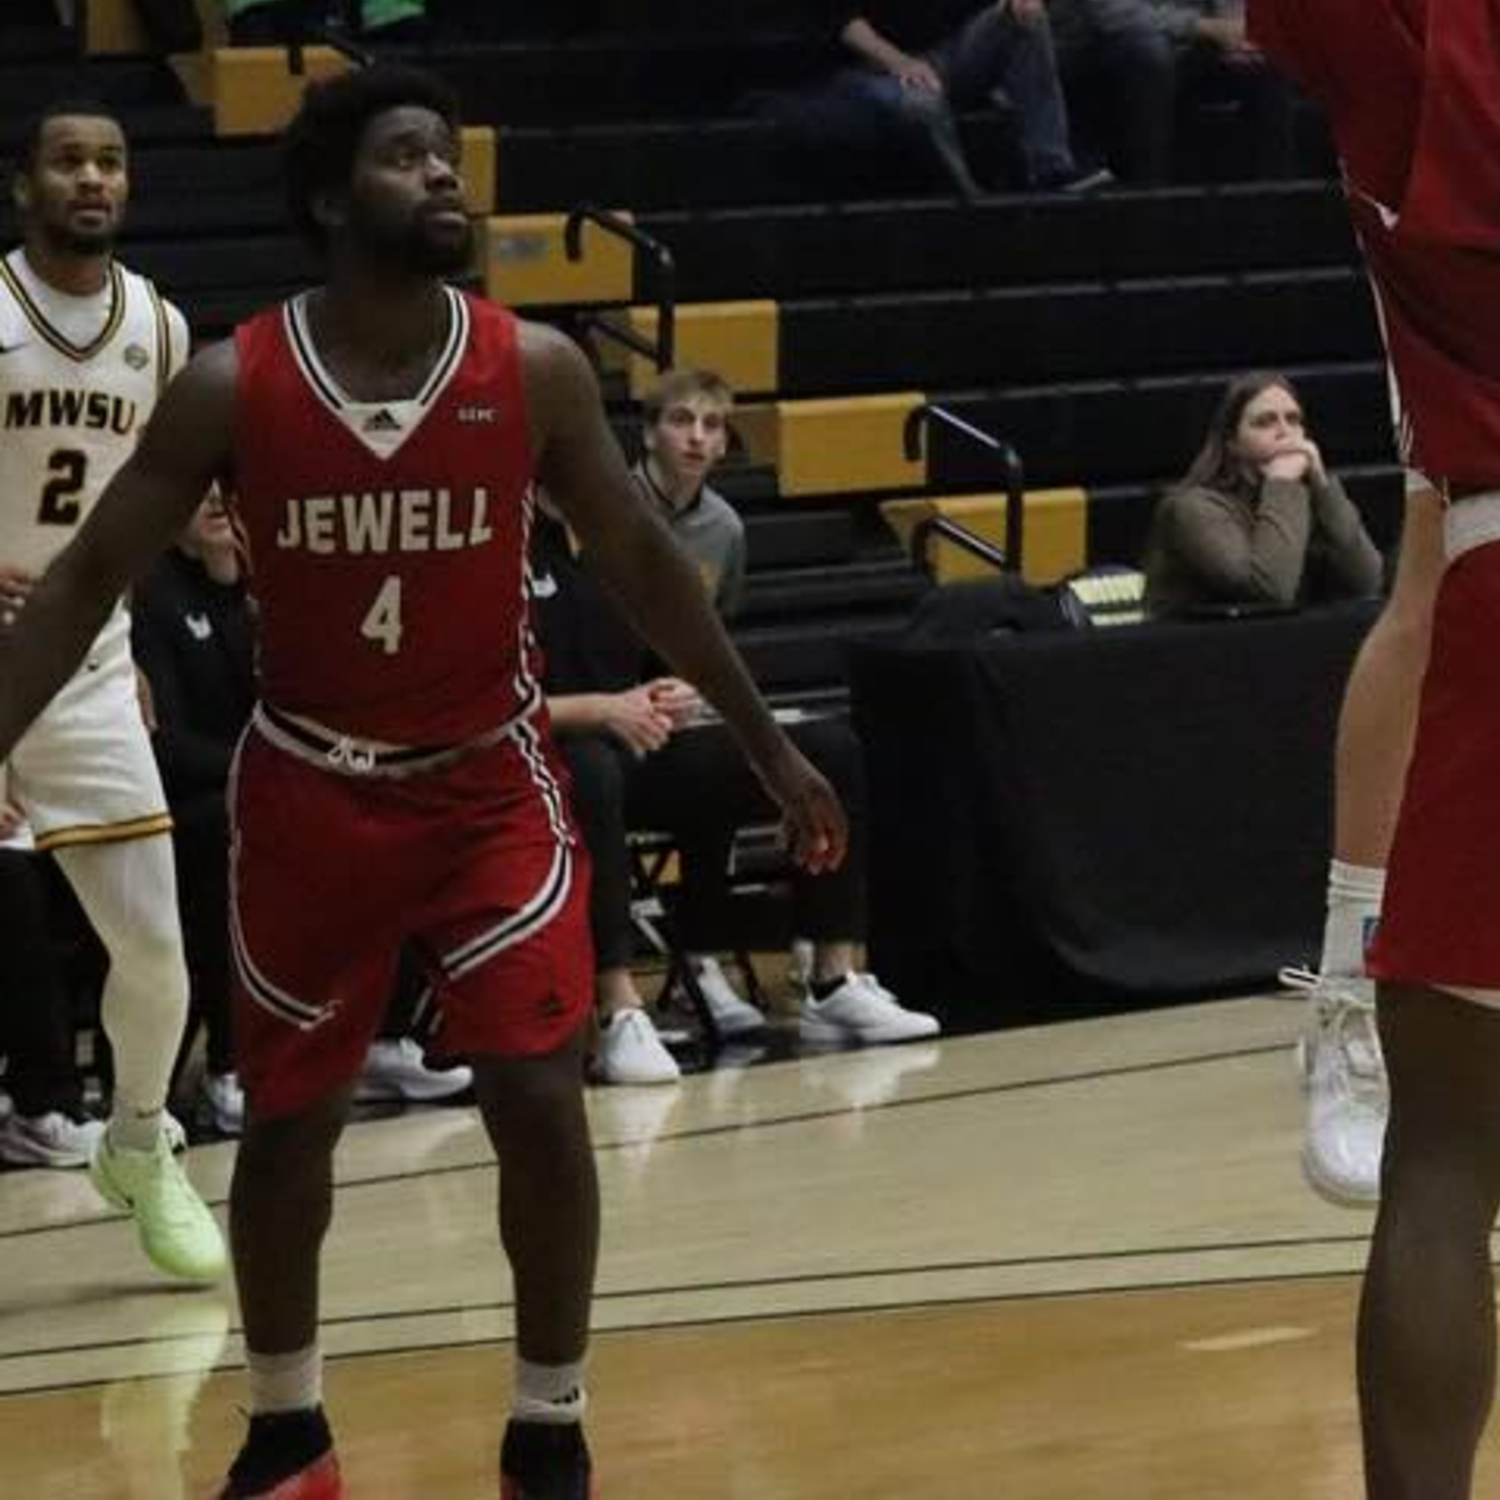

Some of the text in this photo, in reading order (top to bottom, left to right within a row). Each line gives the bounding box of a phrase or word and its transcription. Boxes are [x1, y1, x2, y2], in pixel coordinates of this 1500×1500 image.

[4, 388, 137, 436] MWSU
[36, 449, 88, 526] 2
[276, 486, 494, 555] JEWELL
[359, 574, 404, 655] 4
